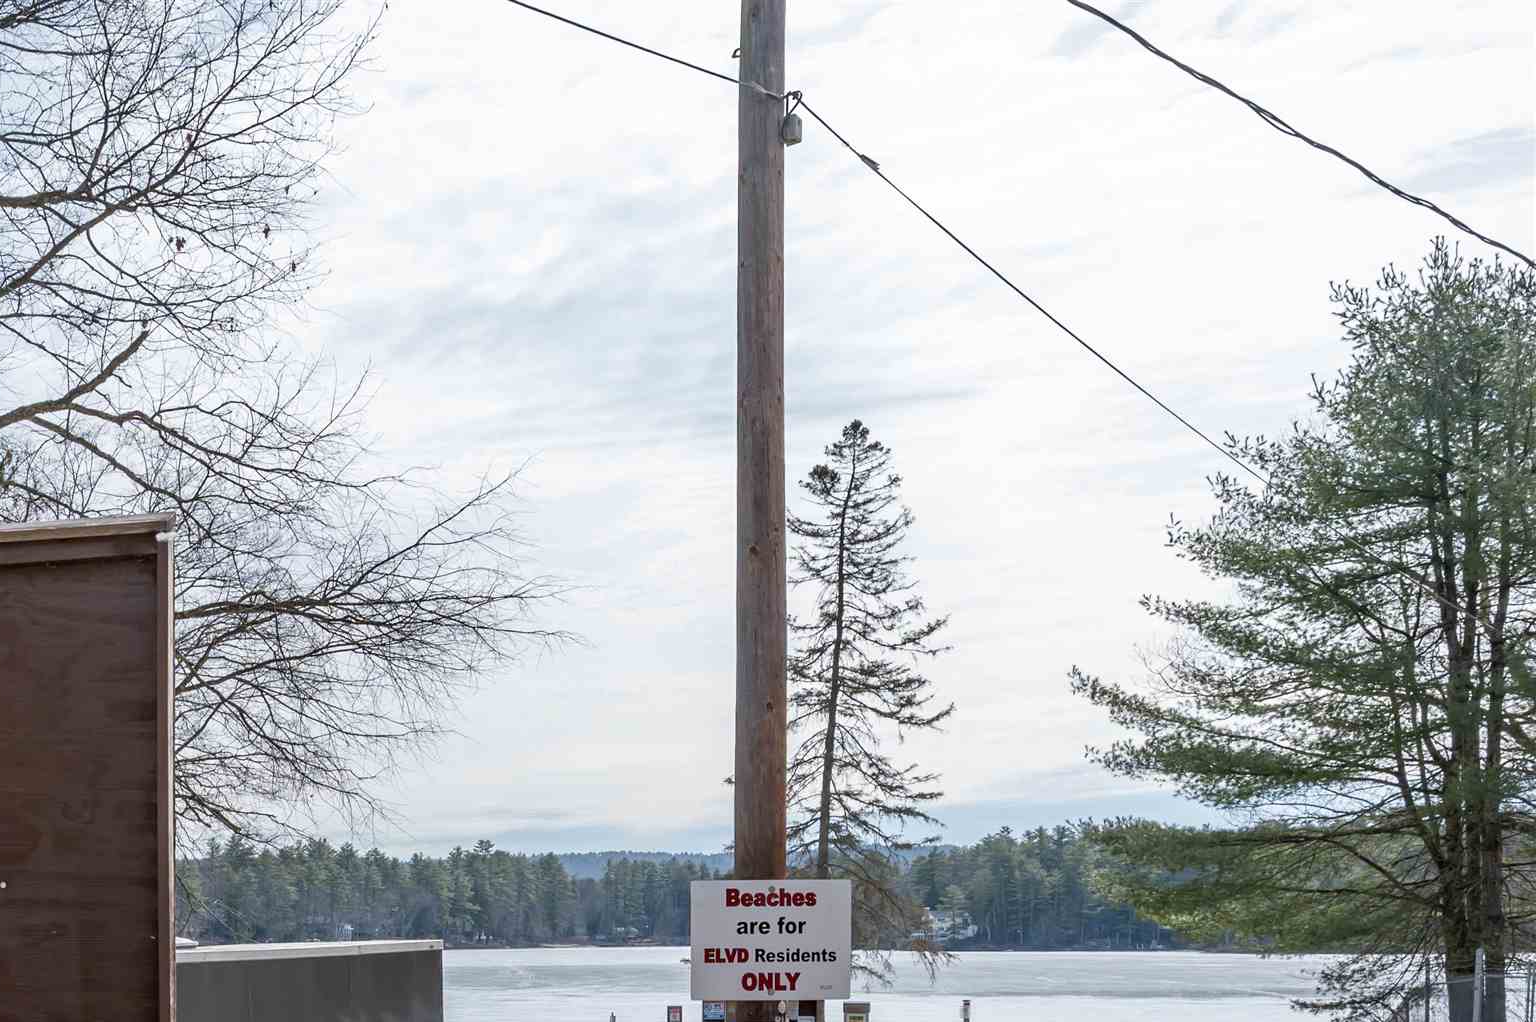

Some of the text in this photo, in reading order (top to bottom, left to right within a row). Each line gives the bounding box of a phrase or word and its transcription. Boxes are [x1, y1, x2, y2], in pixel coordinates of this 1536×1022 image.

[725, 888, 817, 907] Beaches
[736, 917, 807, 935] are for
[703, 948, 837, 964] ELVD Residents
[741, 972, 801, 992] ONLY
